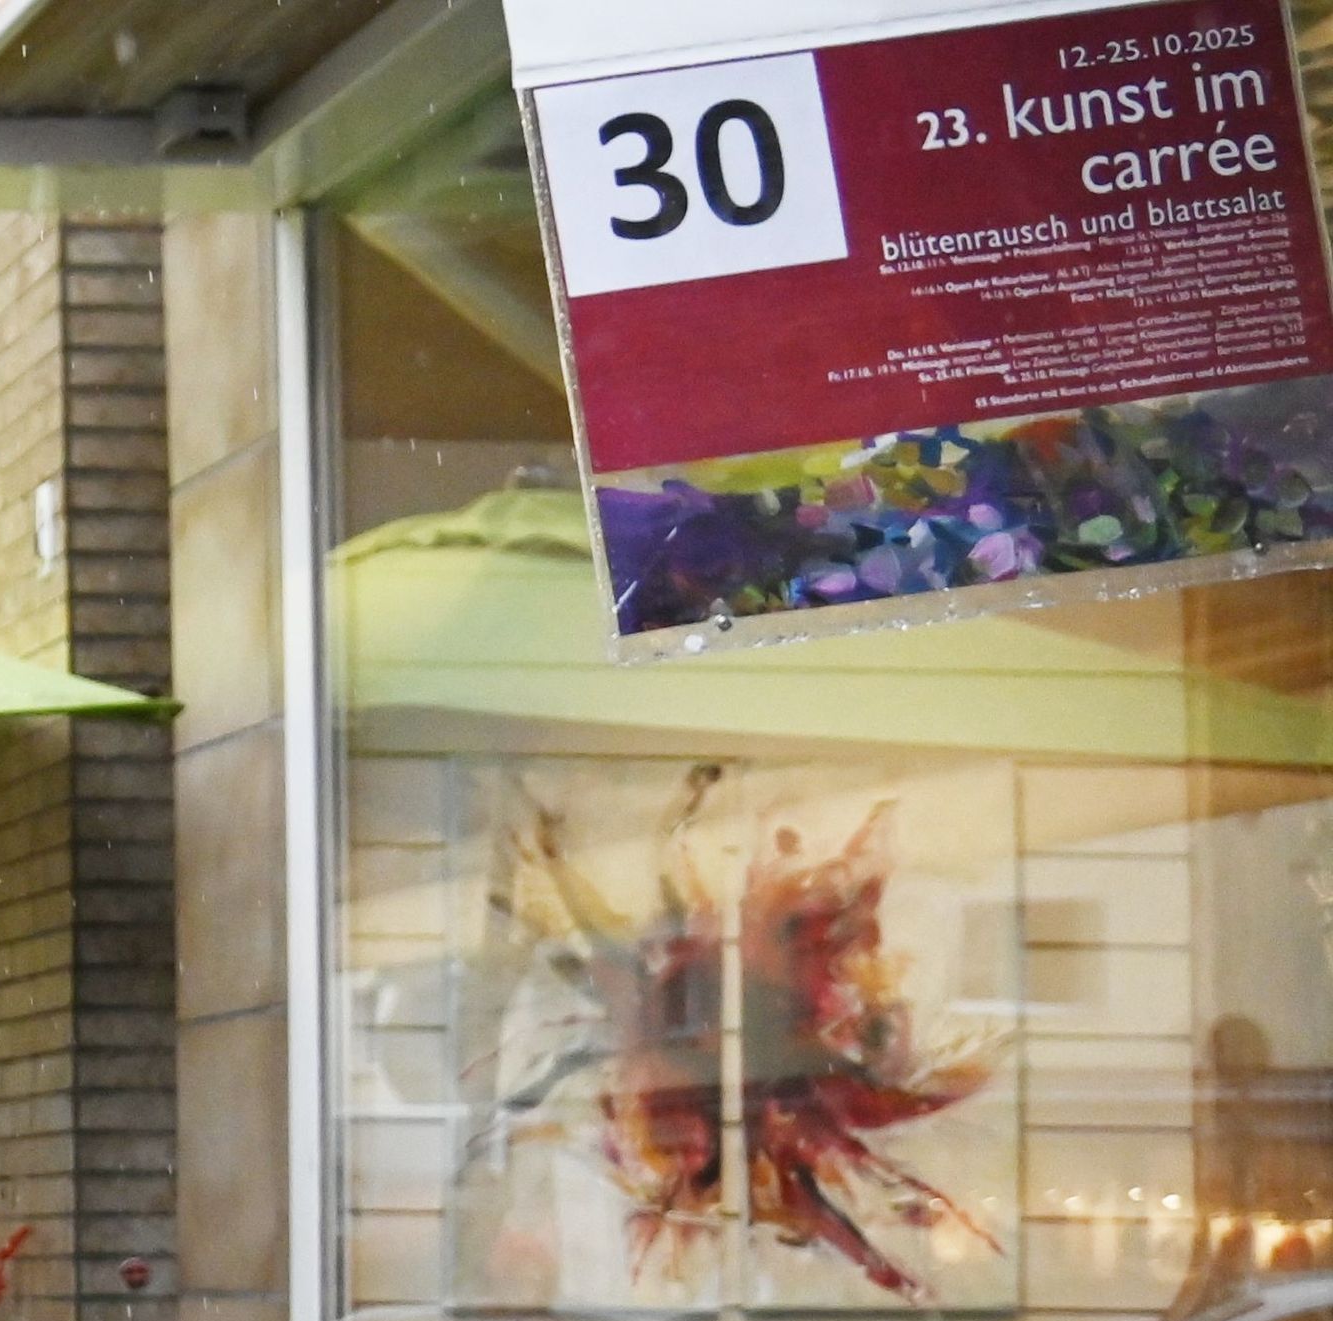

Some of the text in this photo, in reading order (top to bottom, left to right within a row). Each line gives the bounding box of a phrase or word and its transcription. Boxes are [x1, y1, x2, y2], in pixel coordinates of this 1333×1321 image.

[1059, 24, 1255, 69] 12.-25.10.2025
[917, 62, 1265, 150] 23. kunst im
[599, 99, 784, 240] 30
[1082, 120, 1277, 194] carrée
[881, 187, 1286, 262] blütenrausch und blattsalat
[944, 279, 973, 294] Open
[1013, 284, 1039, 298] Open
